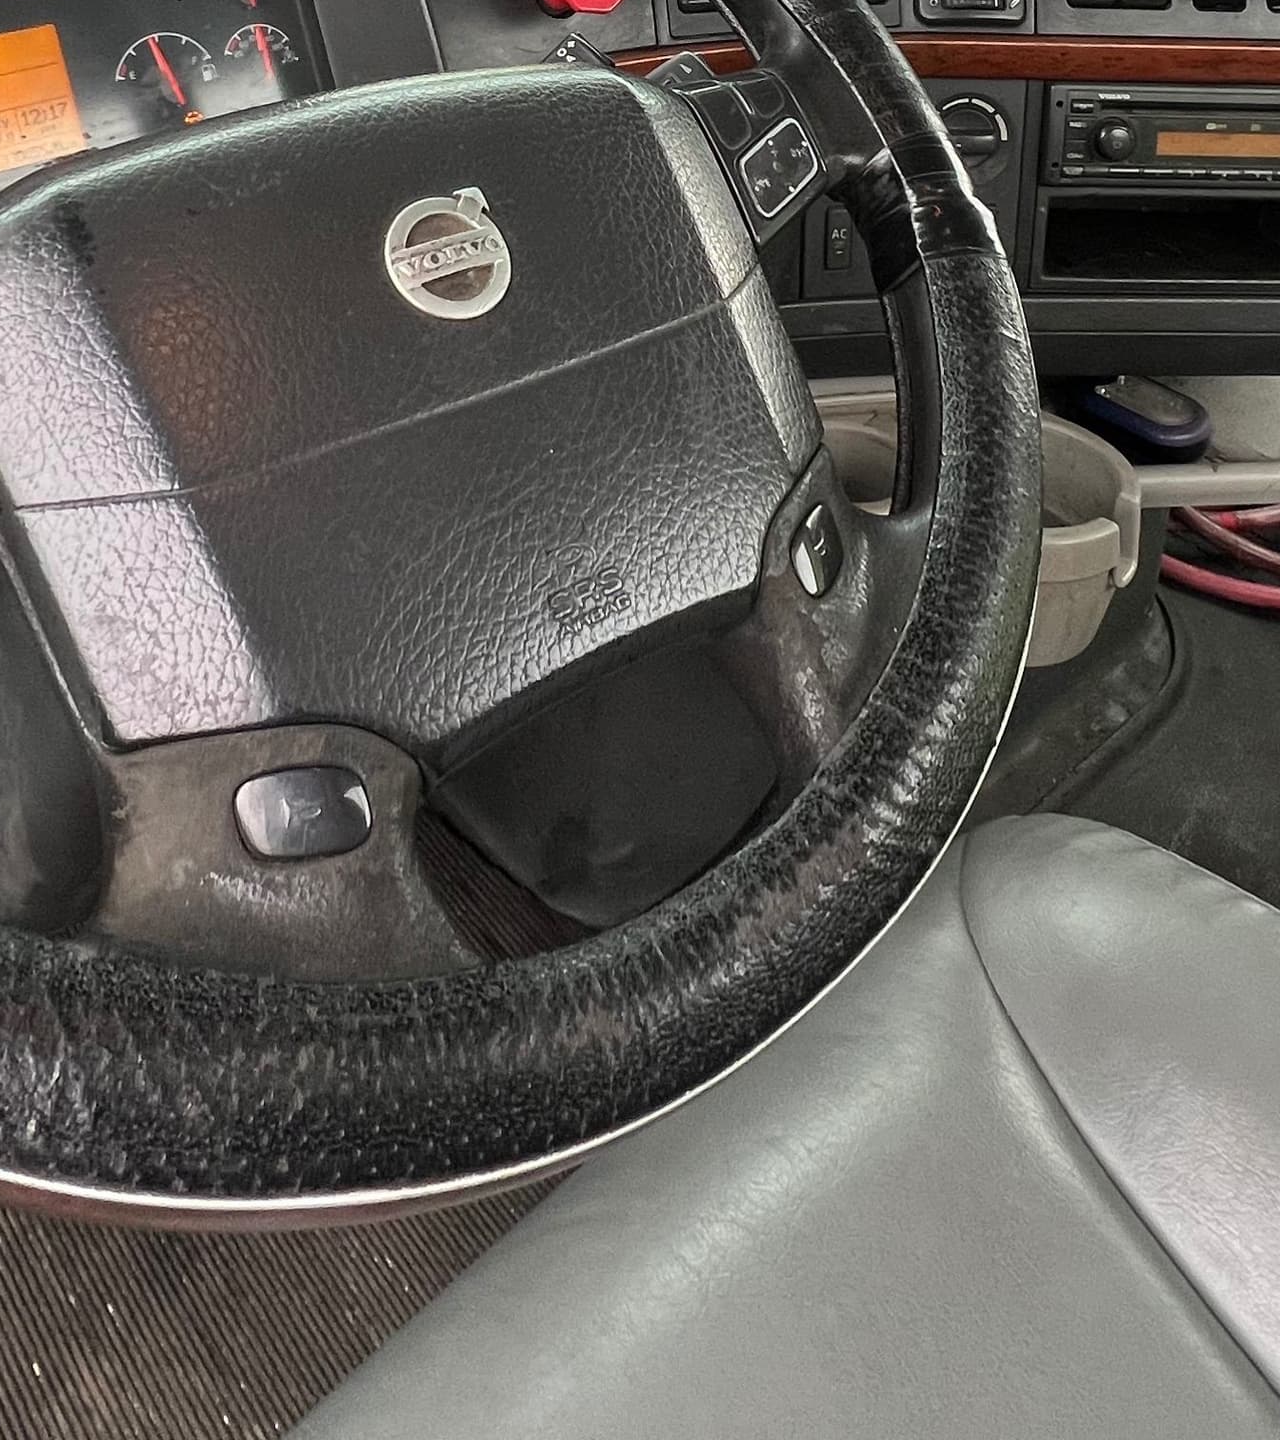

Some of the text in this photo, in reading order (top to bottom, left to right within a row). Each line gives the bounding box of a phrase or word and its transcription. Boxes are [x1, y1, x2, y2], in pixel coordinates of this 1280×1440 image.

[21, 101, 68, 126] 12:17
[831, 228, 848, 240] AC
[394, 235, 504, 276] VOLVO
